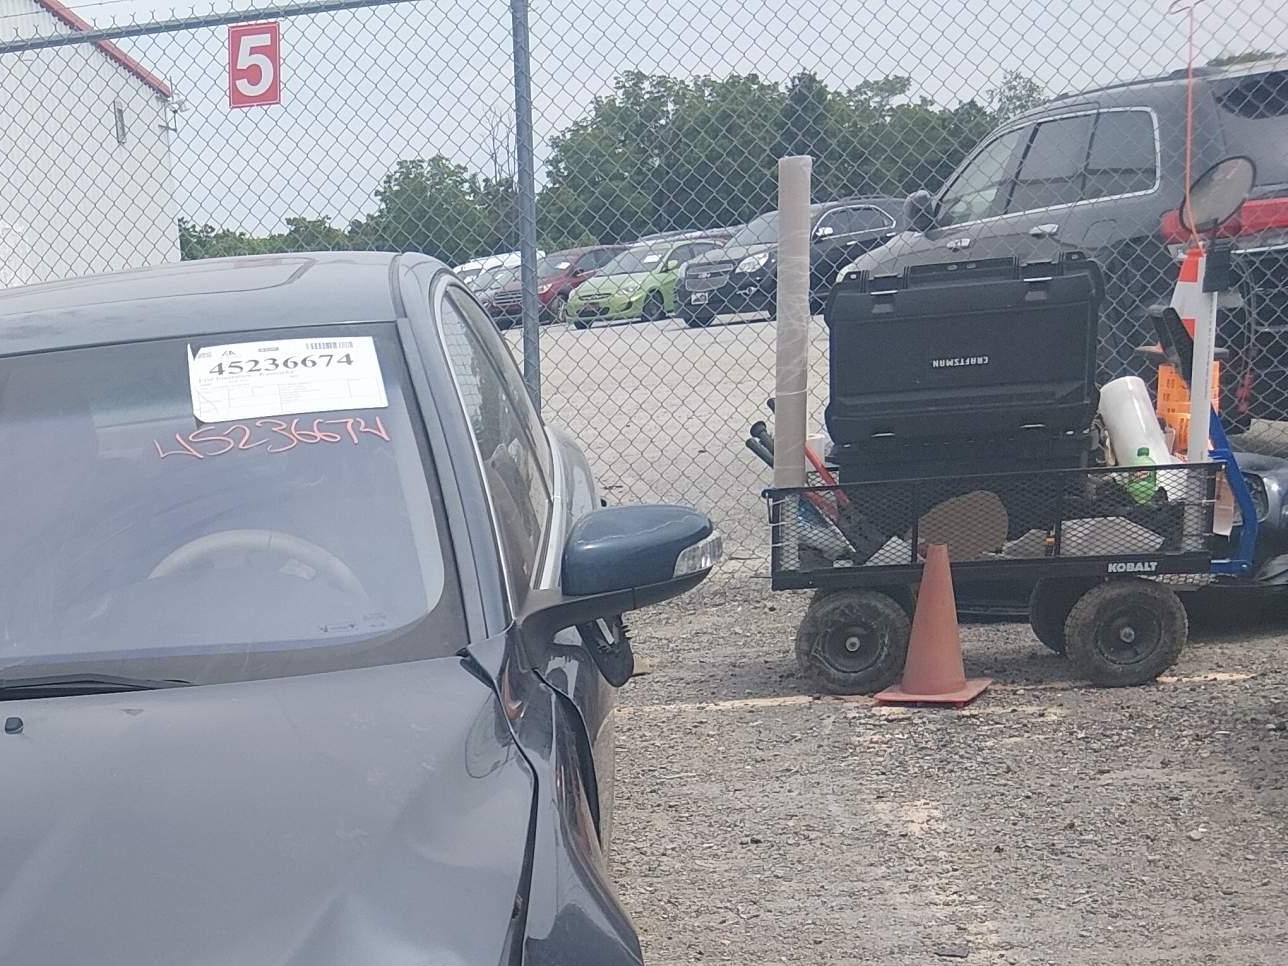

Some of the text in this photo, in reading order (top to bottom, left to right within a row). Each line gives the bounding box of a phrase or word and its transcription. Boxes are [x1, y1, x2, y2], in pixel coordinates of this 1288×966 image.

[235, 33, 274, 97] 5
[208, 353, 354, 376] 45236674
[932, 356, 989, 368] CRAFTSMAN
[154, 416, 391, 459] 45236674
[1107, 561, 1158, 573] KOBALT
